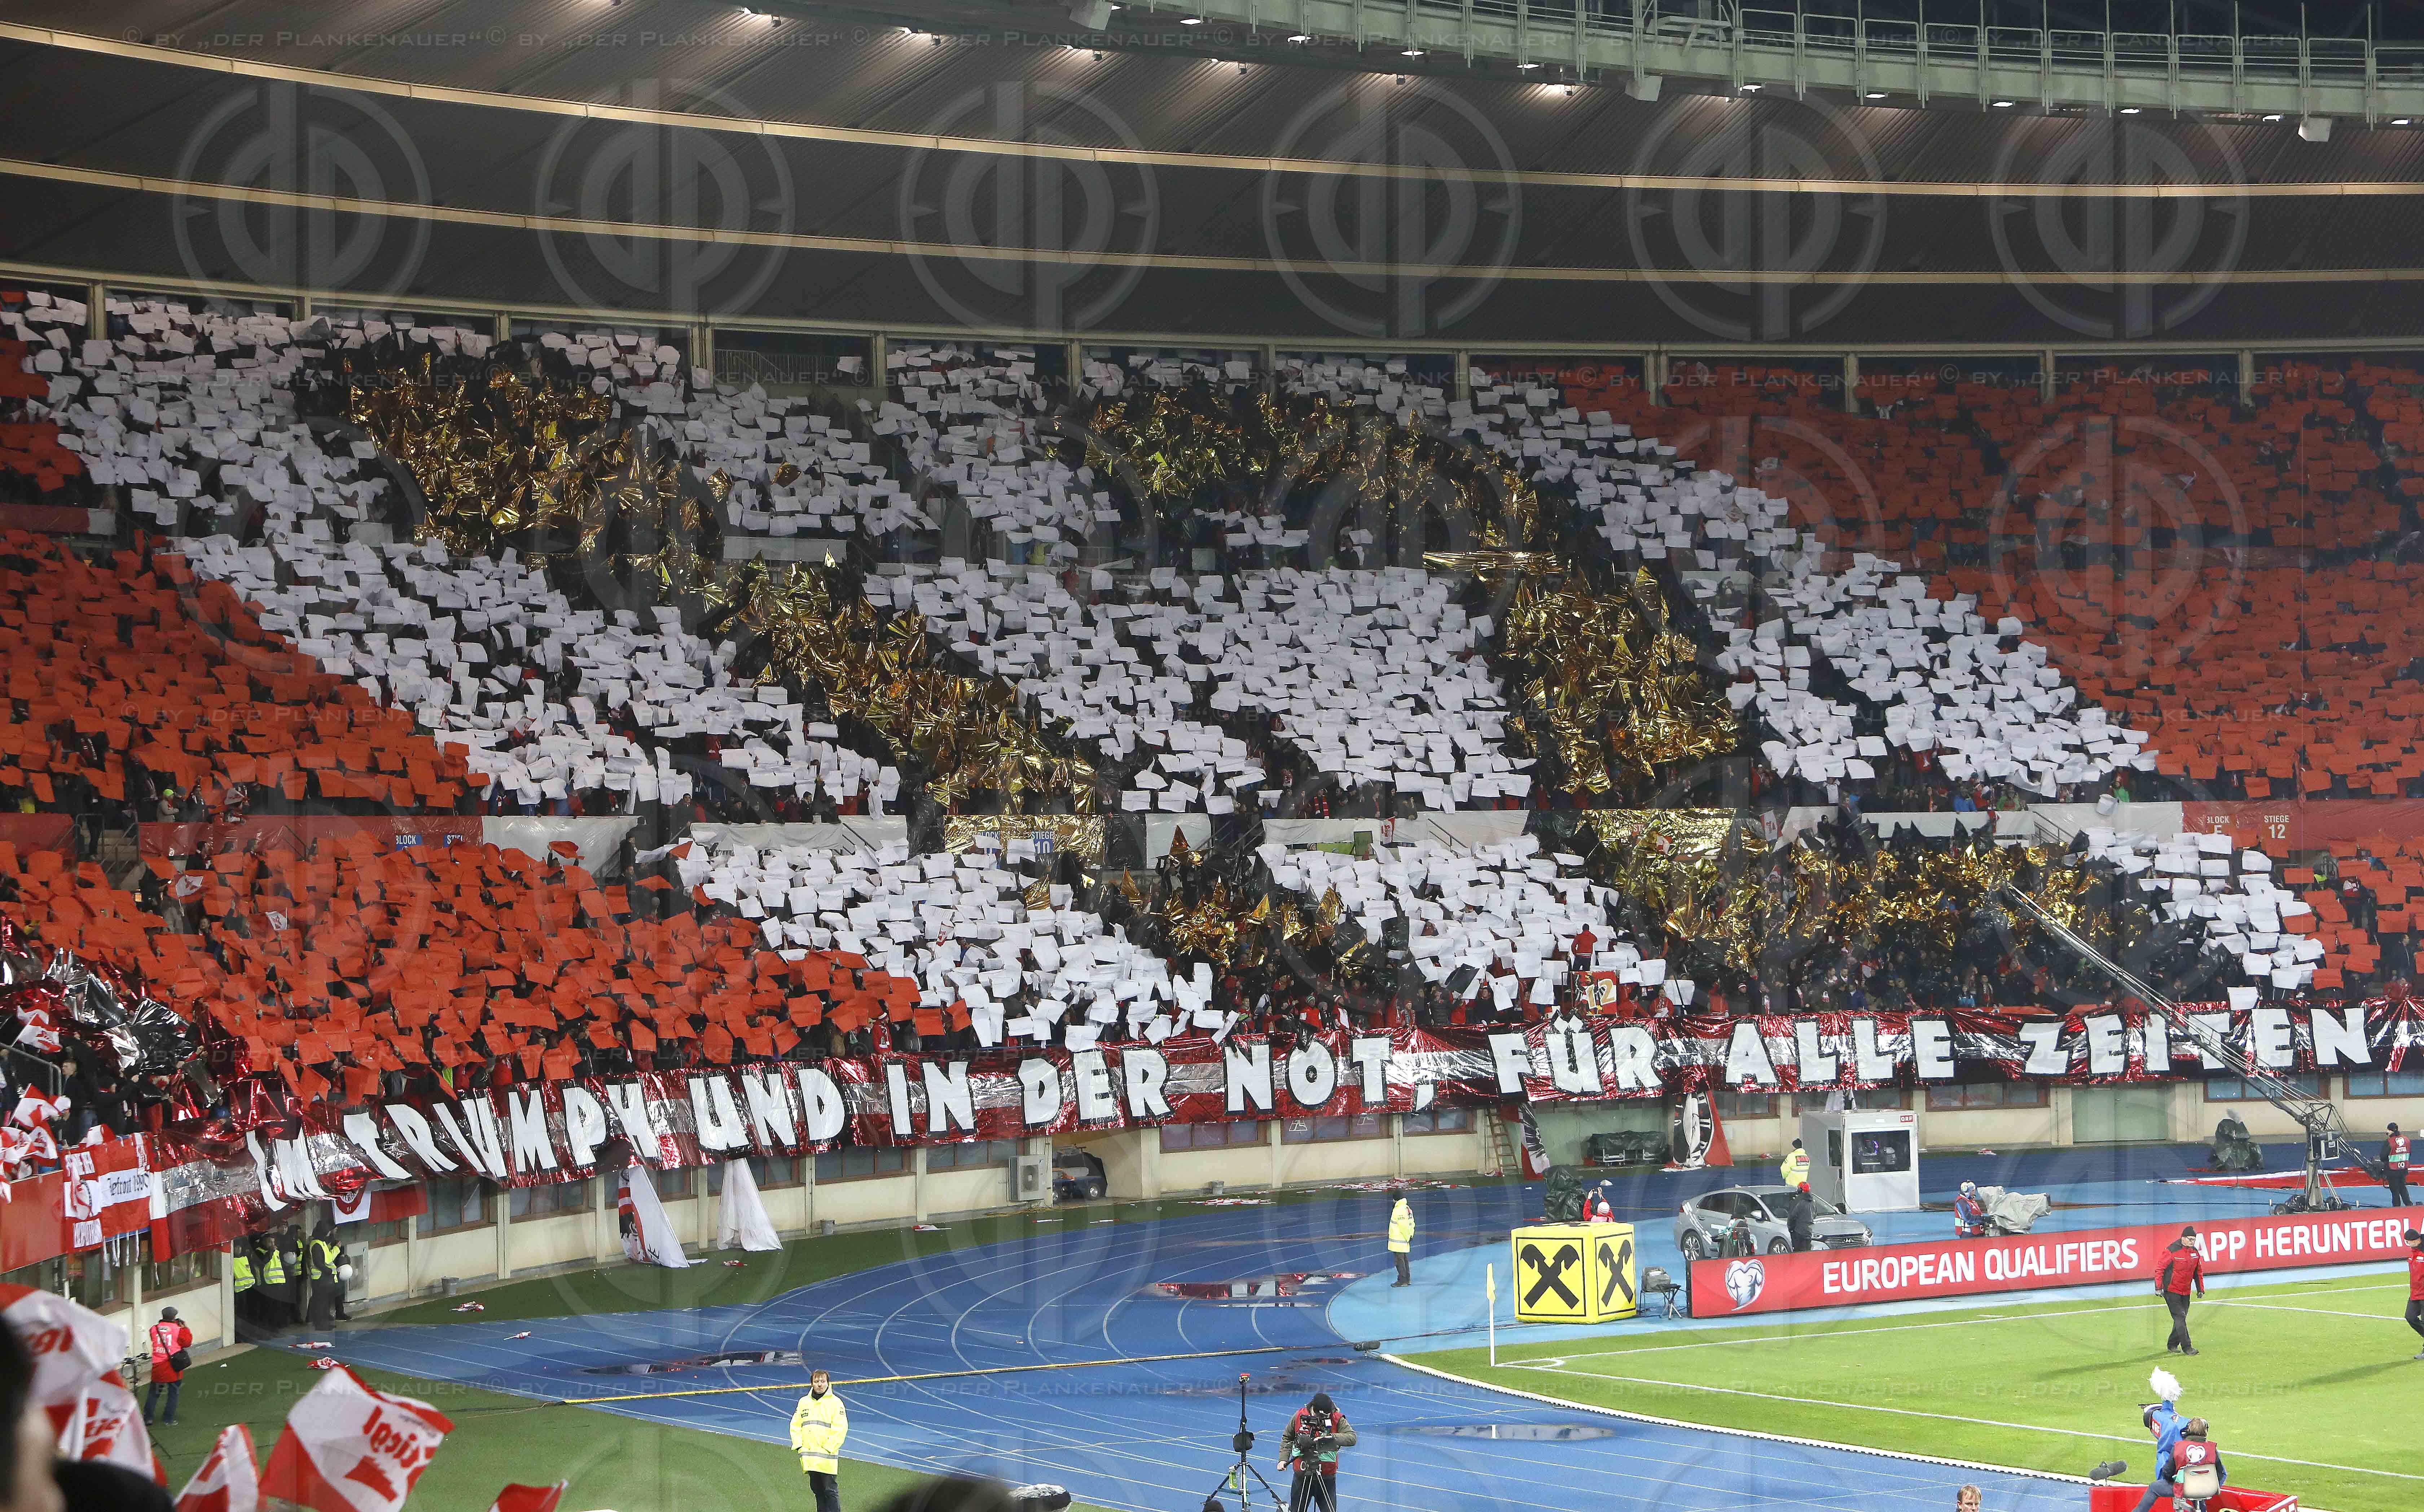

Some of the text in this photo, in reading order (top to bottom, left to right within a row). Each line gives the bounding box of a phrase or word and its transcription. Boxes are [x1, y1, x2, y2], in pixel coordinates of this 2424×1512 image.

[396, 835, 416, 844] BLOCK
[1031, 831, 1053, 840] STIEGE
[2268, 824, 2285, 839] 12
[1035, 841, 1050, 854] 10
[1585, 979, 1616, 1009] 12
[246, 1126, 329, 1212] IM
[343, 1083, 659, 1179] TRIUMPH
[688, 1068, 846, 1148] UND
[886, 1061, 974, 1135] IN
[1018, 1049, 1171, 1125] DER
[1488, 1015, 1663, 1094] FÜR
[1726, 1019, 1954, 1084] ALLE
[2019, 1008, 2372, 1075] ZEITEN
[2194, 1230, 2246, 1262] APP
[1823, 1238, 2138, 1293] EUROPEAN QUALIFIERS
